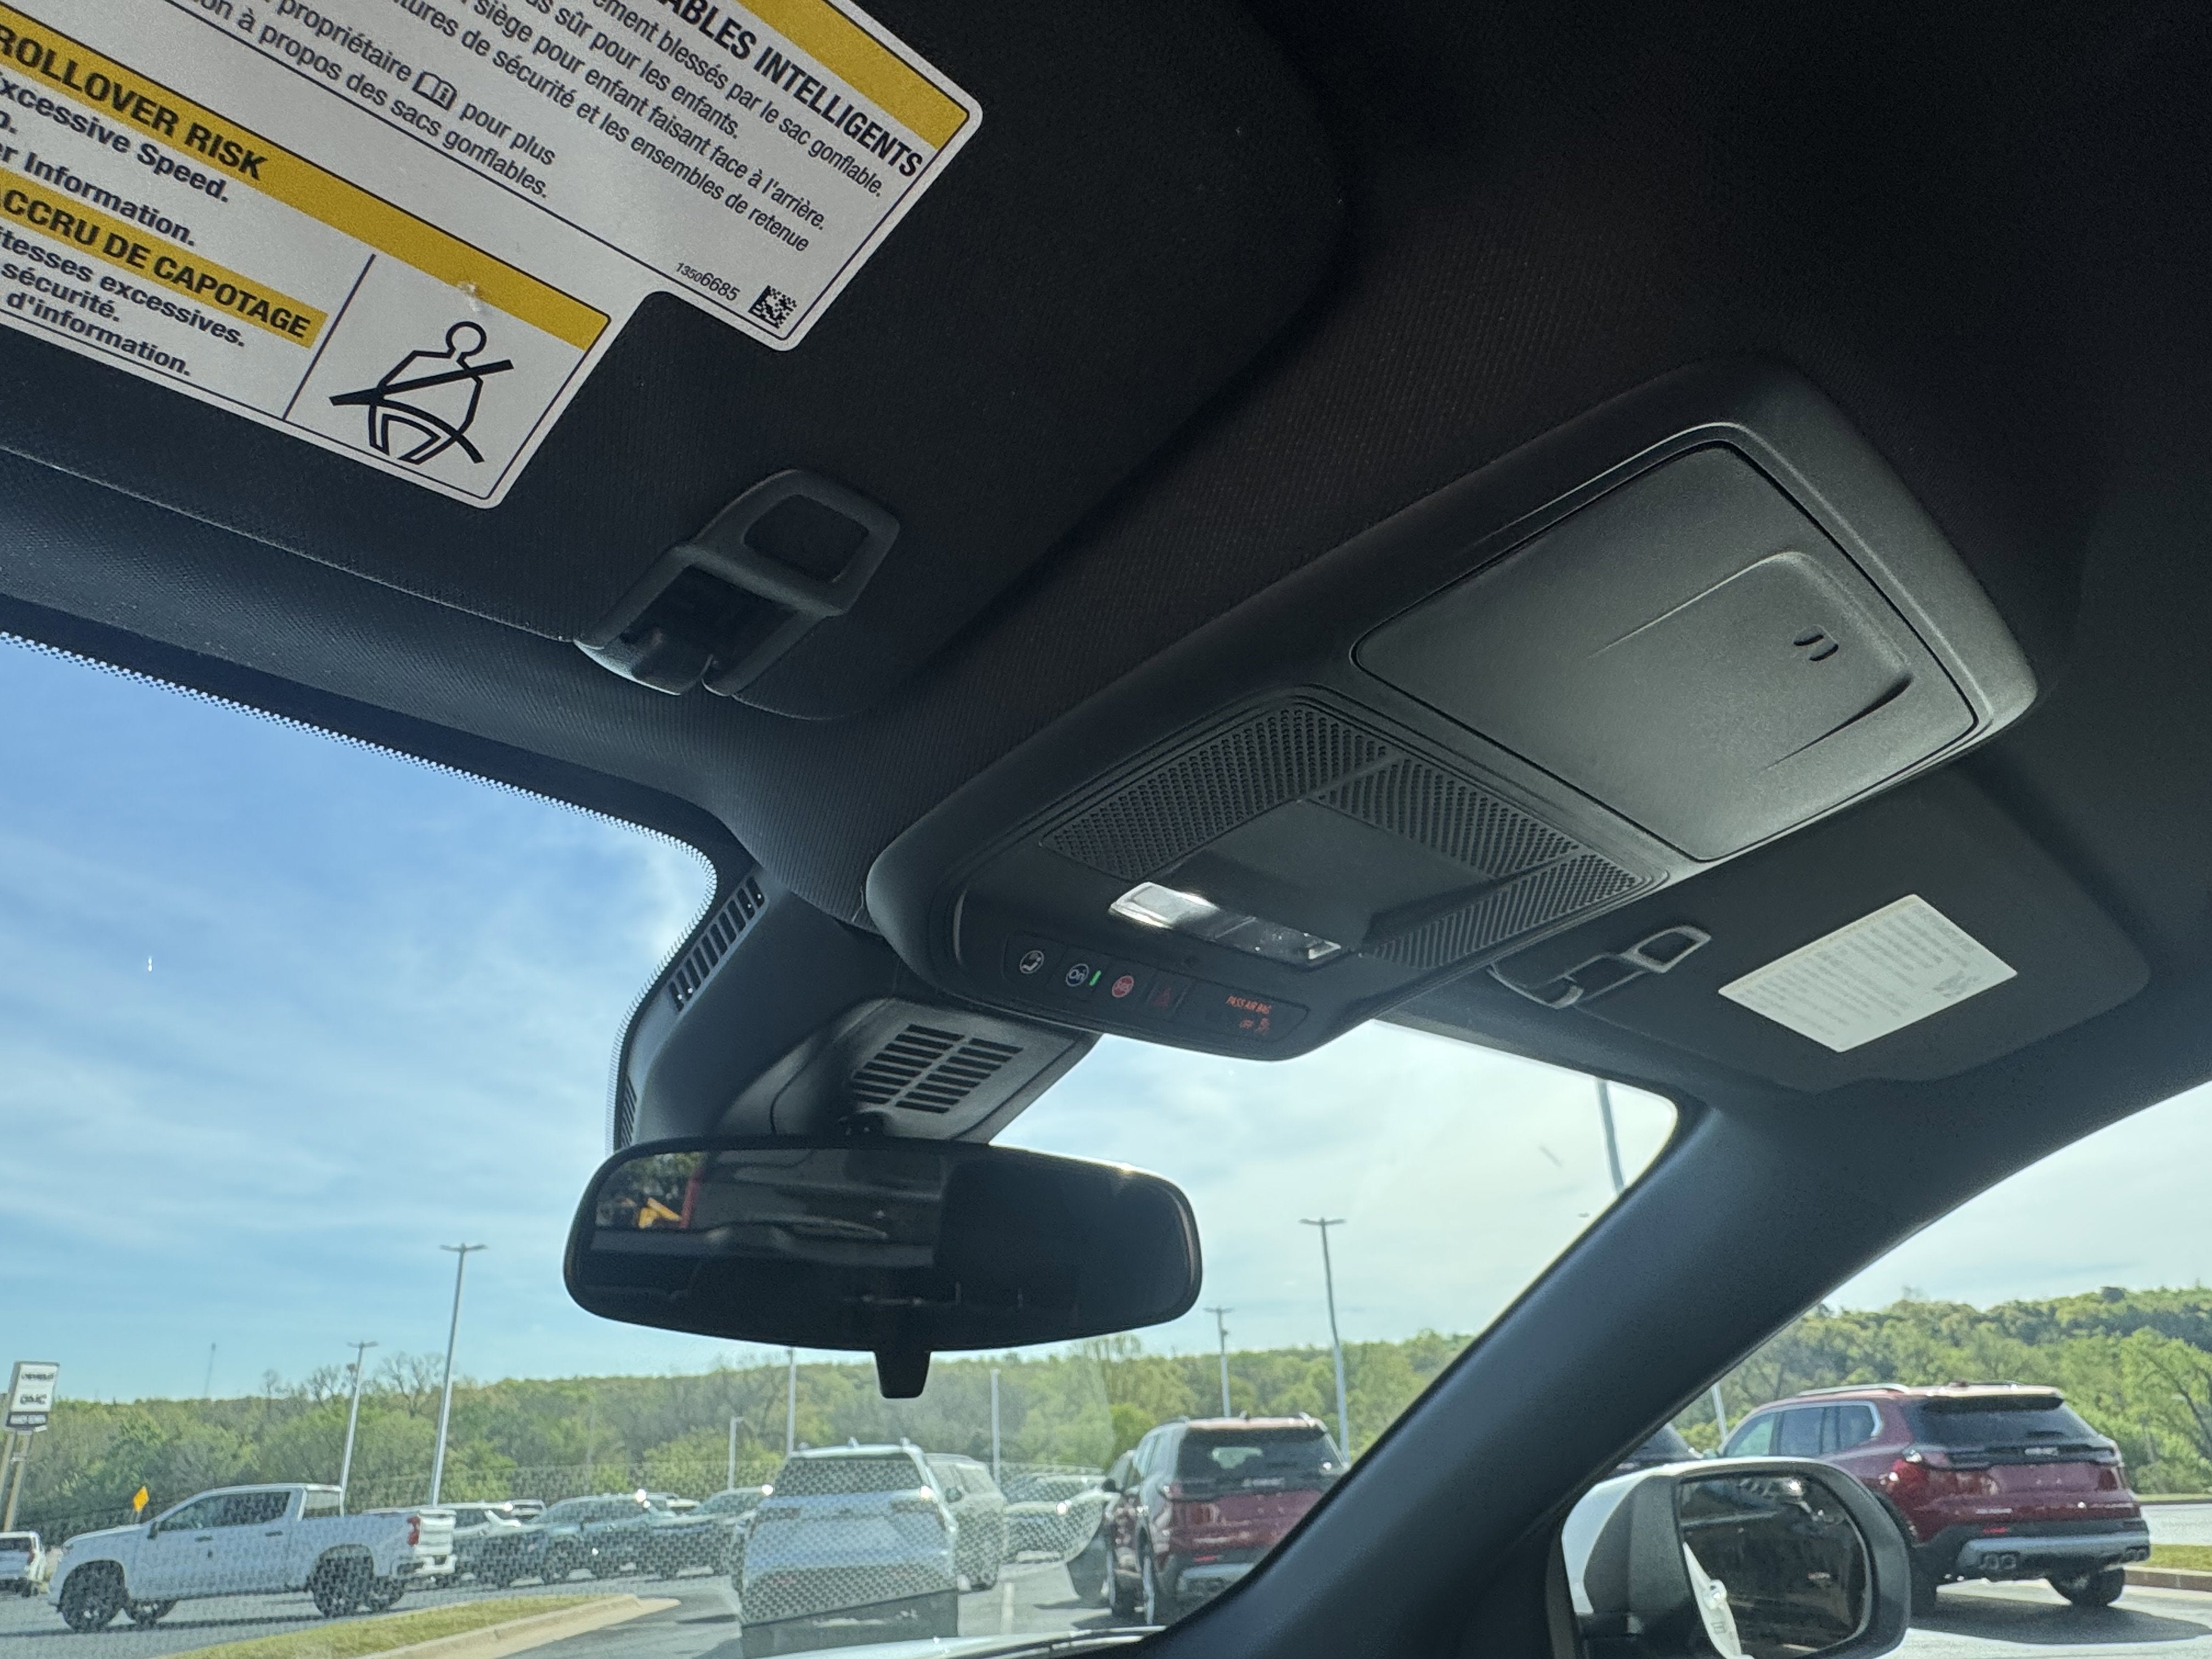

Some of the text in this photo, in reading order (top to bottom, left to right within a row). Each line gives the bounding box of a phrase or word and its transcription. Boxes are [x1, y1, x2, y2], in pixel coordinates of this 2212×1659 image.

[0, 71, 228, 203] xcessive Speed.
[236, 8, 256, 33] à
[258, 25, 342, 81] propos
[346, 74, 388, 106] des
[389, 100, 442, 137] sacs
[442, 131, 546, 198] gonflables.
[277, 0, 555, 165] propriétaire pour plus
[474, 0, 825, 230] siège pour enfant faisant face à l'arrière.
[555, 8, 593, 38] sûr
[589, 32, 641, 70] pour
[639, 59, 670, 92] les
[671, 86, 738, 139] enfants.
[657, 30, 729, 89] blessés
[725, 83, 763, 111] par
[759, 100, 779, 123] le
[778, 118, 811, 145] sac
[808, 140, 882, 197] gonflable.
[753, 46, 923, 177] INTELLIGENTS
[24, 152, 194, 246] Information.
[184, 122, 268, 181] RISK
[461, 30, 490, 57] de
[492, 50, 577, 108] sécurité
[577, 103, 601, 125] et
[599, 112, 629, 142] les
[630, 137, 724, 199] ensembles
[725, 194, 748, 214] de
[748, 208, 809, 251] retenue
[0, 189, 311, 338] CCRU DE CAPOTAGE
[0, 225, 244, 347] tesses excessives.
[1, 263, 120, 322] sécurité.
[676, 263, 741, 301] 13506685
[6, 292, 190, 376] d'information.
